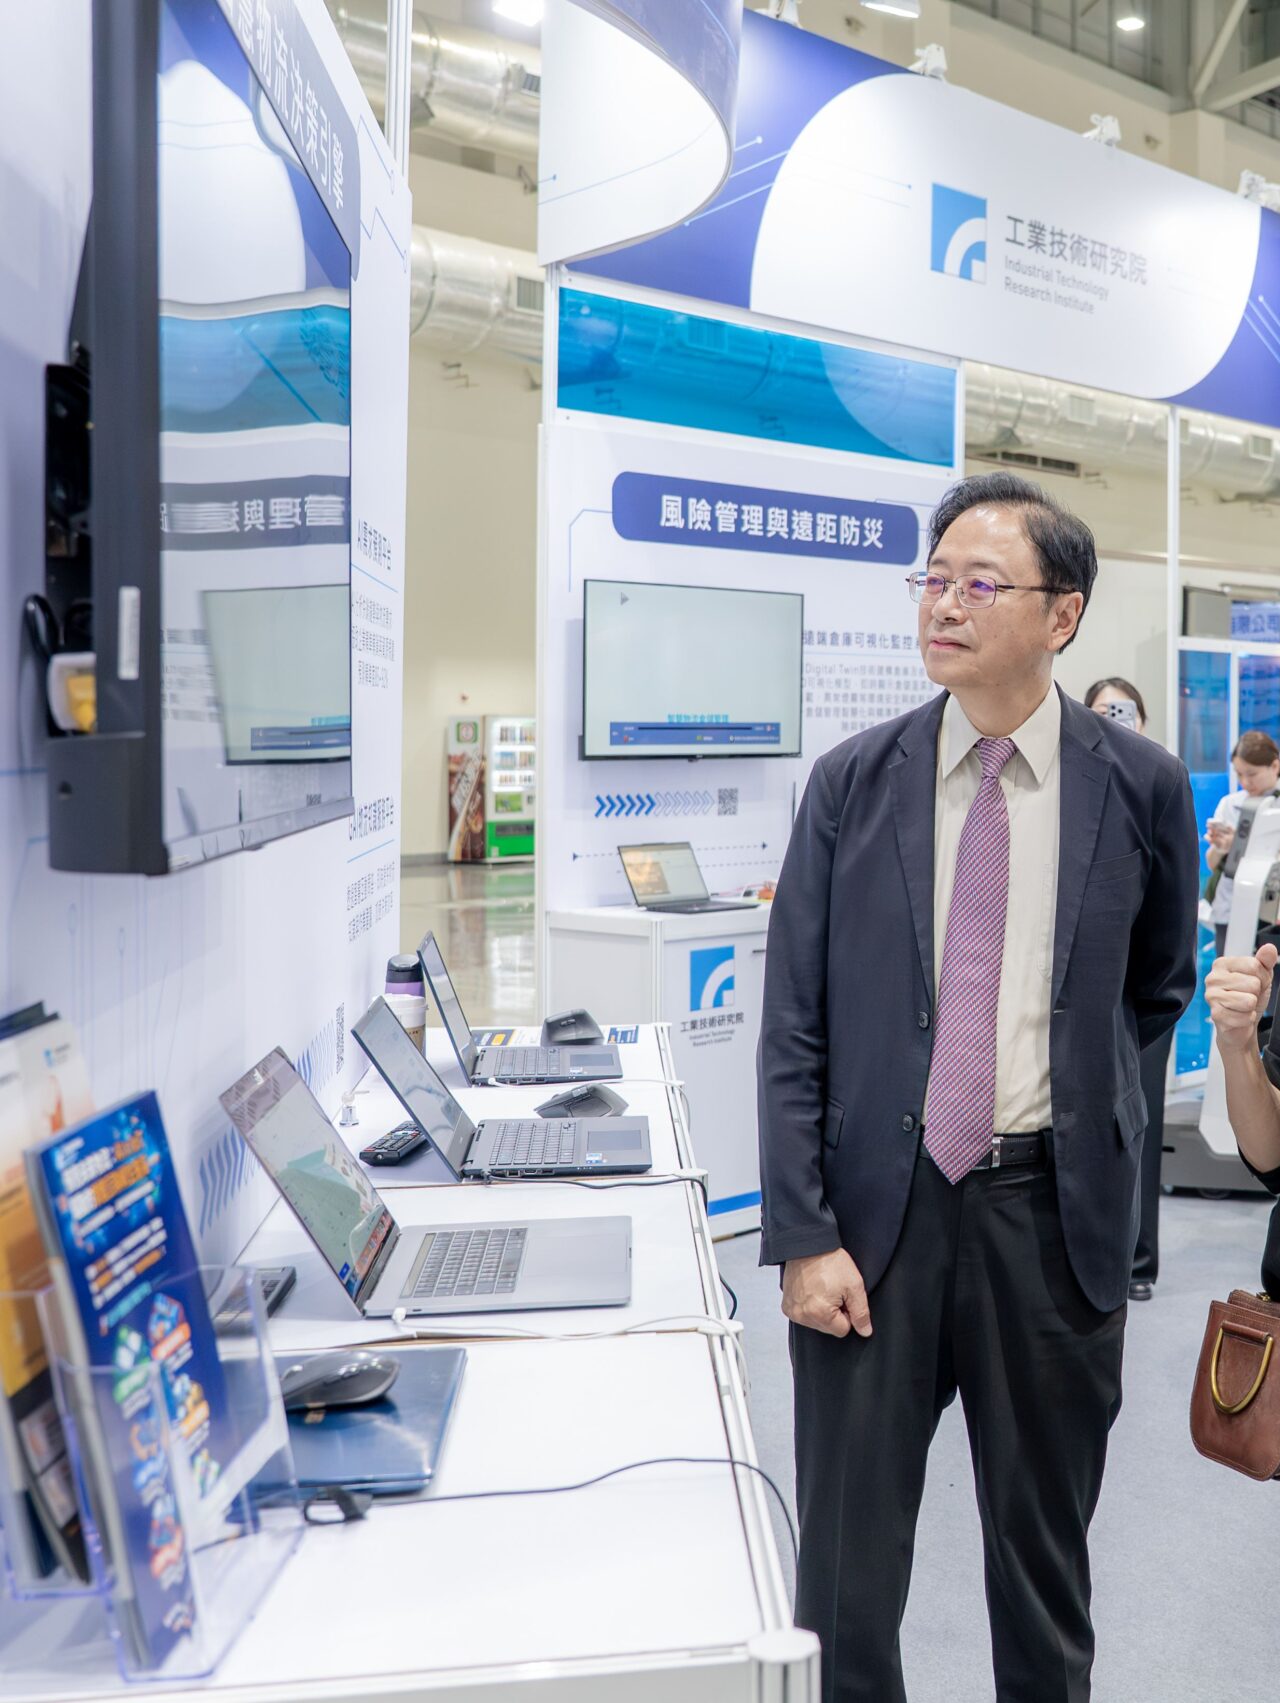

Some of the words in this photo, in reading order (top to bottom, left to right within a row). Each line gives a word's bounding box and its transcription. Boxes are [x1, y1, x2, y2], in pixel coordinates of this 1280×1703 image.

[1005, 215, 1149, 286] 工業技術研究院
[1004, 255, 1054, 282] Industrial
[1056, 269, 1109, 302] Technology
[1004, 276, 1052, 302] Research
[1054, 290, 1095, 315] Institute
[660, 494, 883, 549] 風險管理與遠距防災
[802, 630, 919, 650] 遠端倉庫可視化監控
[805, 663, 836, 677] Digital
[681, 1013, 743, 1032] 工業技術研究院
